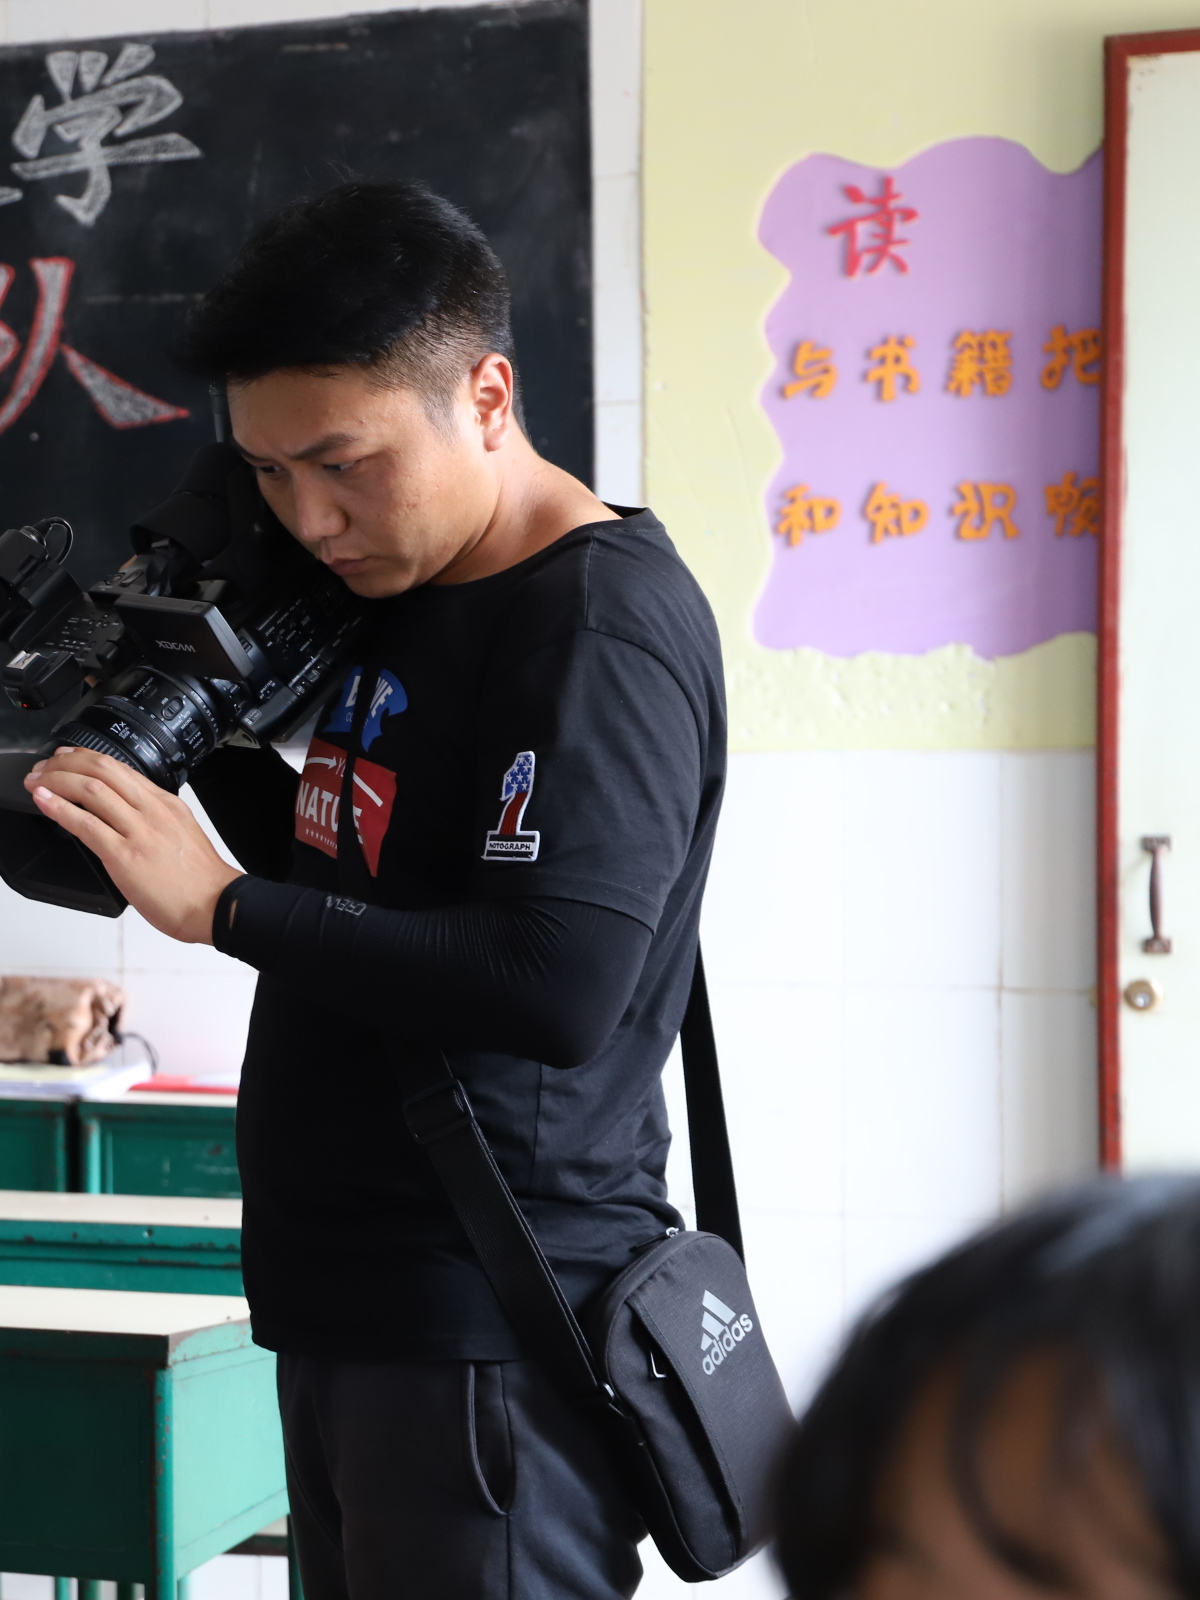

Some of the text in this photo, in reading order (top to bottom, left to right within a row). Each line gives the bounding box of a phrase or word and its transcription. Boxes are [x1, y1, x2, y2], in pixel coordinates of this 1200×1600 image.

[826, 176, 920, 278] 读
[155, 639, 197, 653] XDCAM
[701, 1313, 753, 1376] adidas
